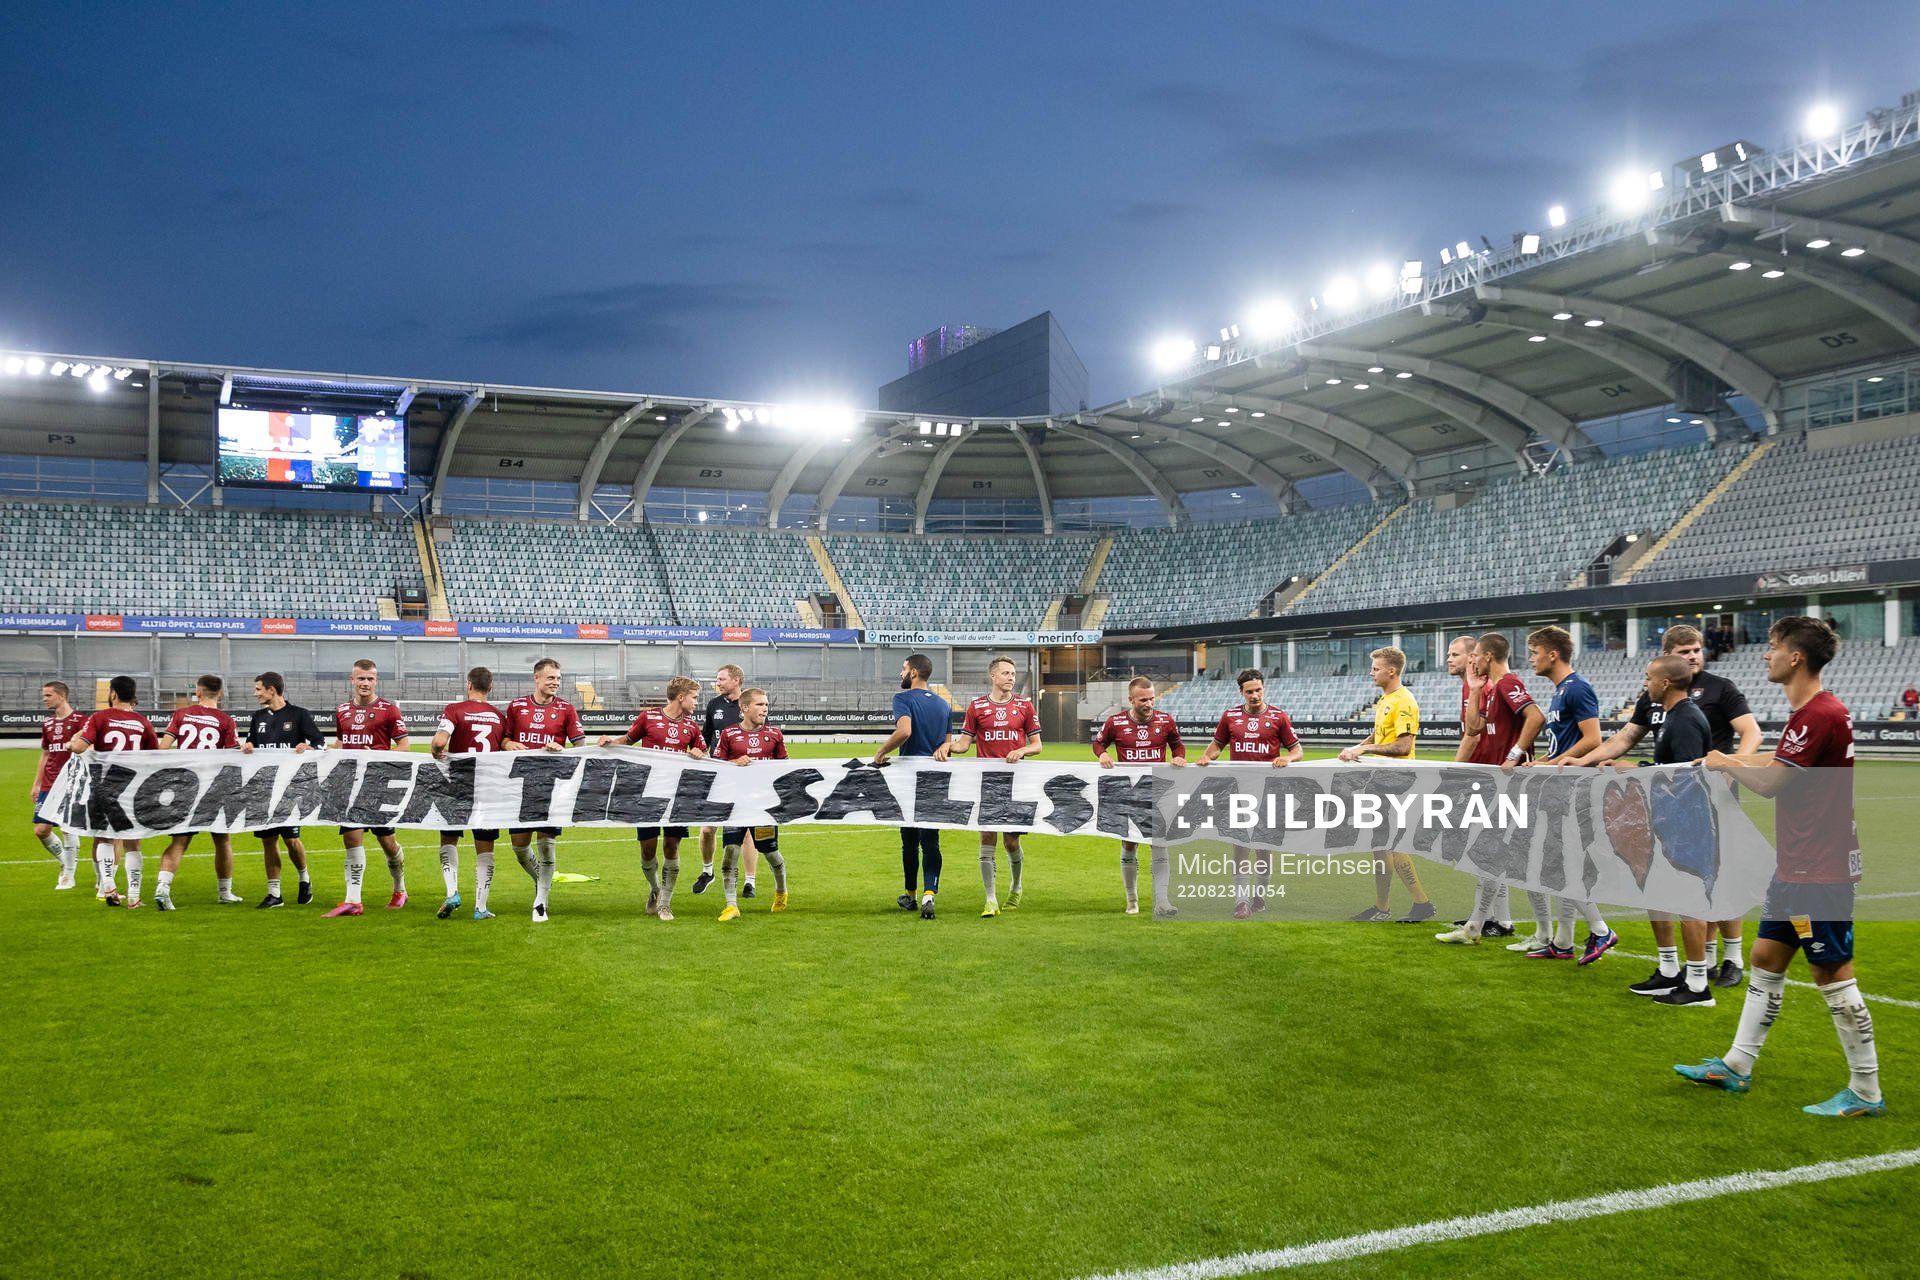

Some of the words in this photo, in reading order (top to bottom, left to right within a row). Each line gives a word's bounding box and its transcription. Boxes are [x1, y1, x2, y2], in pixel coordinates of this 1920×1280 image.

[1820, 332, 1858, 349] D5
[1602, 384, 1631, 398] D4
[48, 433, 76, 445] P3
[500, 458, 524, 468] B4
[1300, 453, 1322, 465] D2
[699, 469, 723, 478] B3
[1204, 468, 1222, 478] D1
[865, 477, 888, 487] B2
[972, 480, 992, 489] B1
[1788, 572, 1829, 586] Gamla
[1830, 567, 1866, 583] Ullevi
[141, 620, 167, 628] ALLTID
[330, 623, 353, 631] P-HUS
[353, 624, 392, 632] NORDSTAN
[472, 626, 511, 634] PARKERING
[521, 627, 562, 635] HEMMAPLAN
[623, 628, 645, 636] ALLTID
[880, 631, 940, 643] merinfo.se
[1038, 631, 1100, 643] merinfo.se
[2, 715, 31, 723] Gamla
[413, 714, 435, 722] Ullevi
[178, 724, 220, 750] 28
[342, 734, 374, 745] BJELIN
[468, 724, 492, 752] 3
[519, 732, 554, 744] BJELIN
[984, 730, 1018, 742] BJELIN
[1879, 729, 1915, 740] Gamla
[104, 731, 143, 751] 21
[1235, 741, 1269, 753] BJELIN
[1126, 749, 1161, 760] BJELIN
[508, 755, 735, 823] TILL
[104, 857, 113, 878] MIKE
[130, 869, 141, 888] MIKE
[351, 863, 363, 886] MIKE
[1760, 992, 1782, 1028] MIKE
